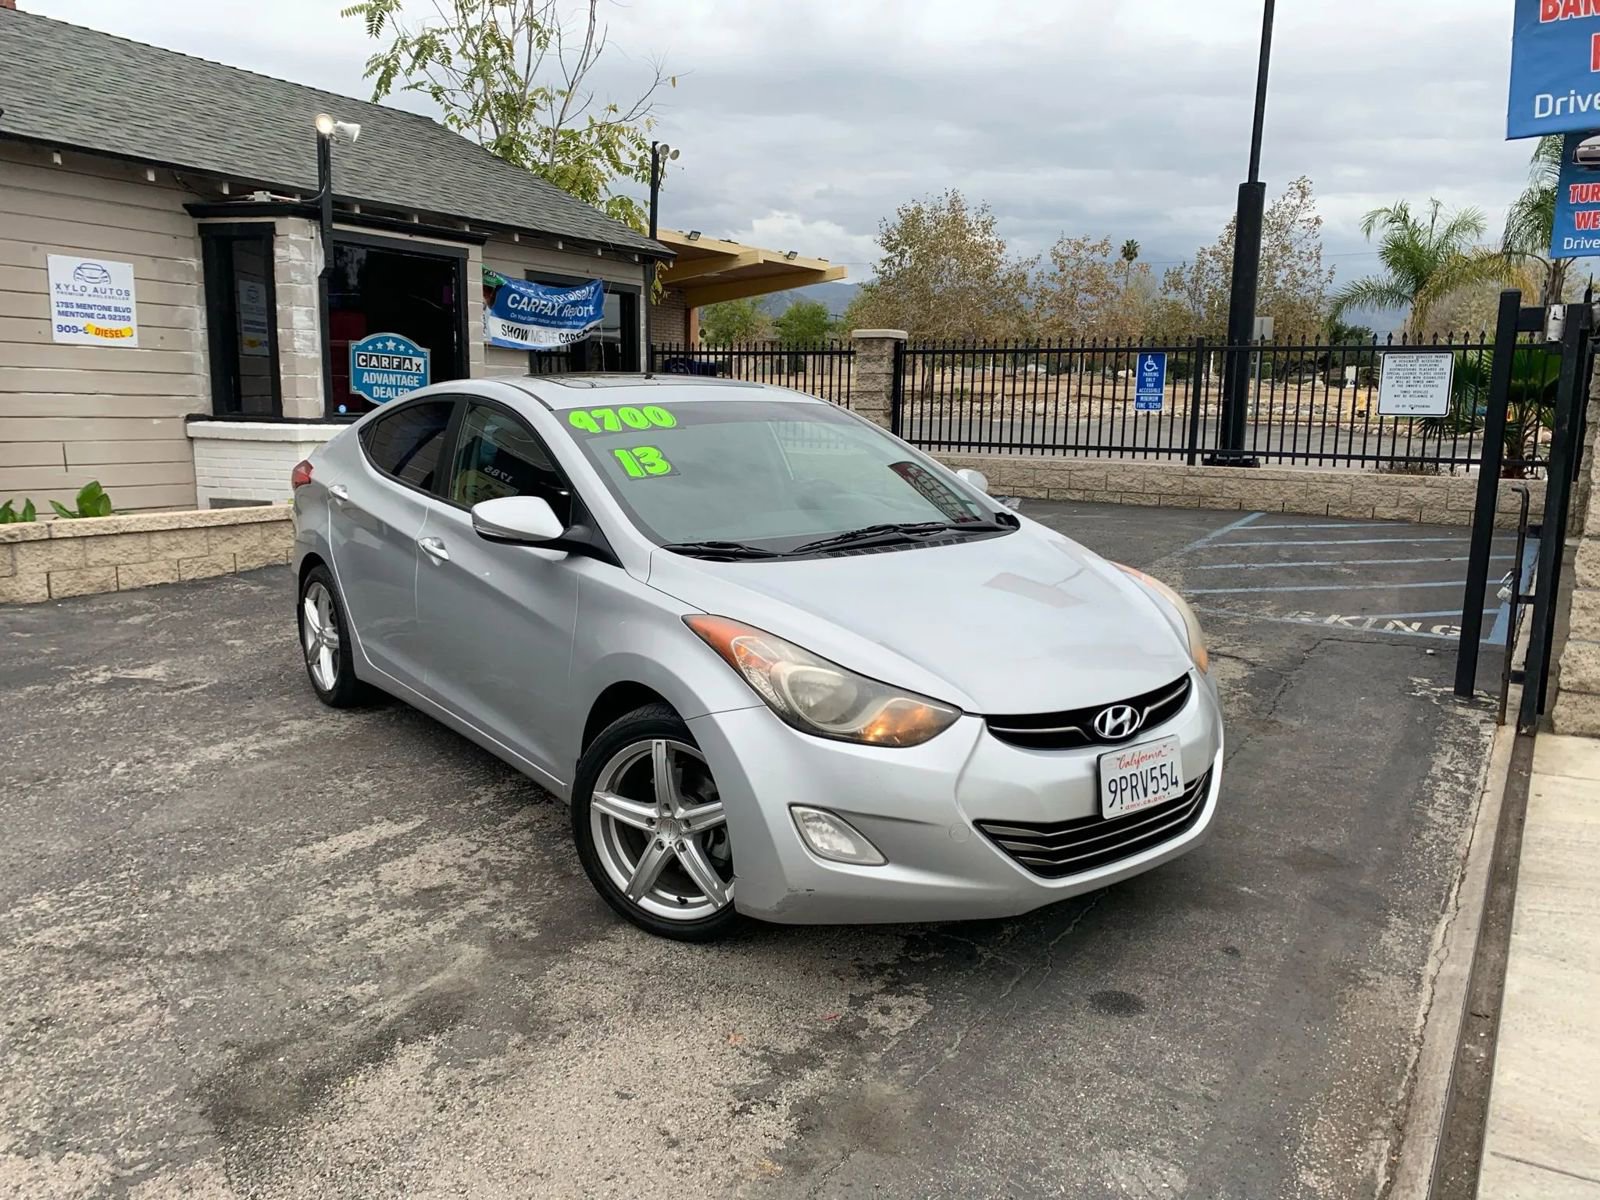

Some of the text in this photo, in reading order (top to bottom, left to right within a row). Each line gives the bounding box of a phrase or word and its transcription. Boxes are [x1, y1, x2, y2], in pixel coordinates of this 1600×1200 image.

[55, 283, 131, 297] XYLO AUTOS
[57, 310, 95, 319] MENTONE
[75, 303, 112, 312] MENTONE
[507, 293, 595, 320] CARFAX Report
[94, 327, 126, 338] DIESEL
[501, 324, 529, 341] SHOW
[358, 355, 421, 373] CARFAX
[362, 372, 420, 387] ADVANTAGE
[614, 447, 671, 478] 13
[1117, 749, 1167, 769] California
[1108, 761, 1179, 808] 9PRV554
